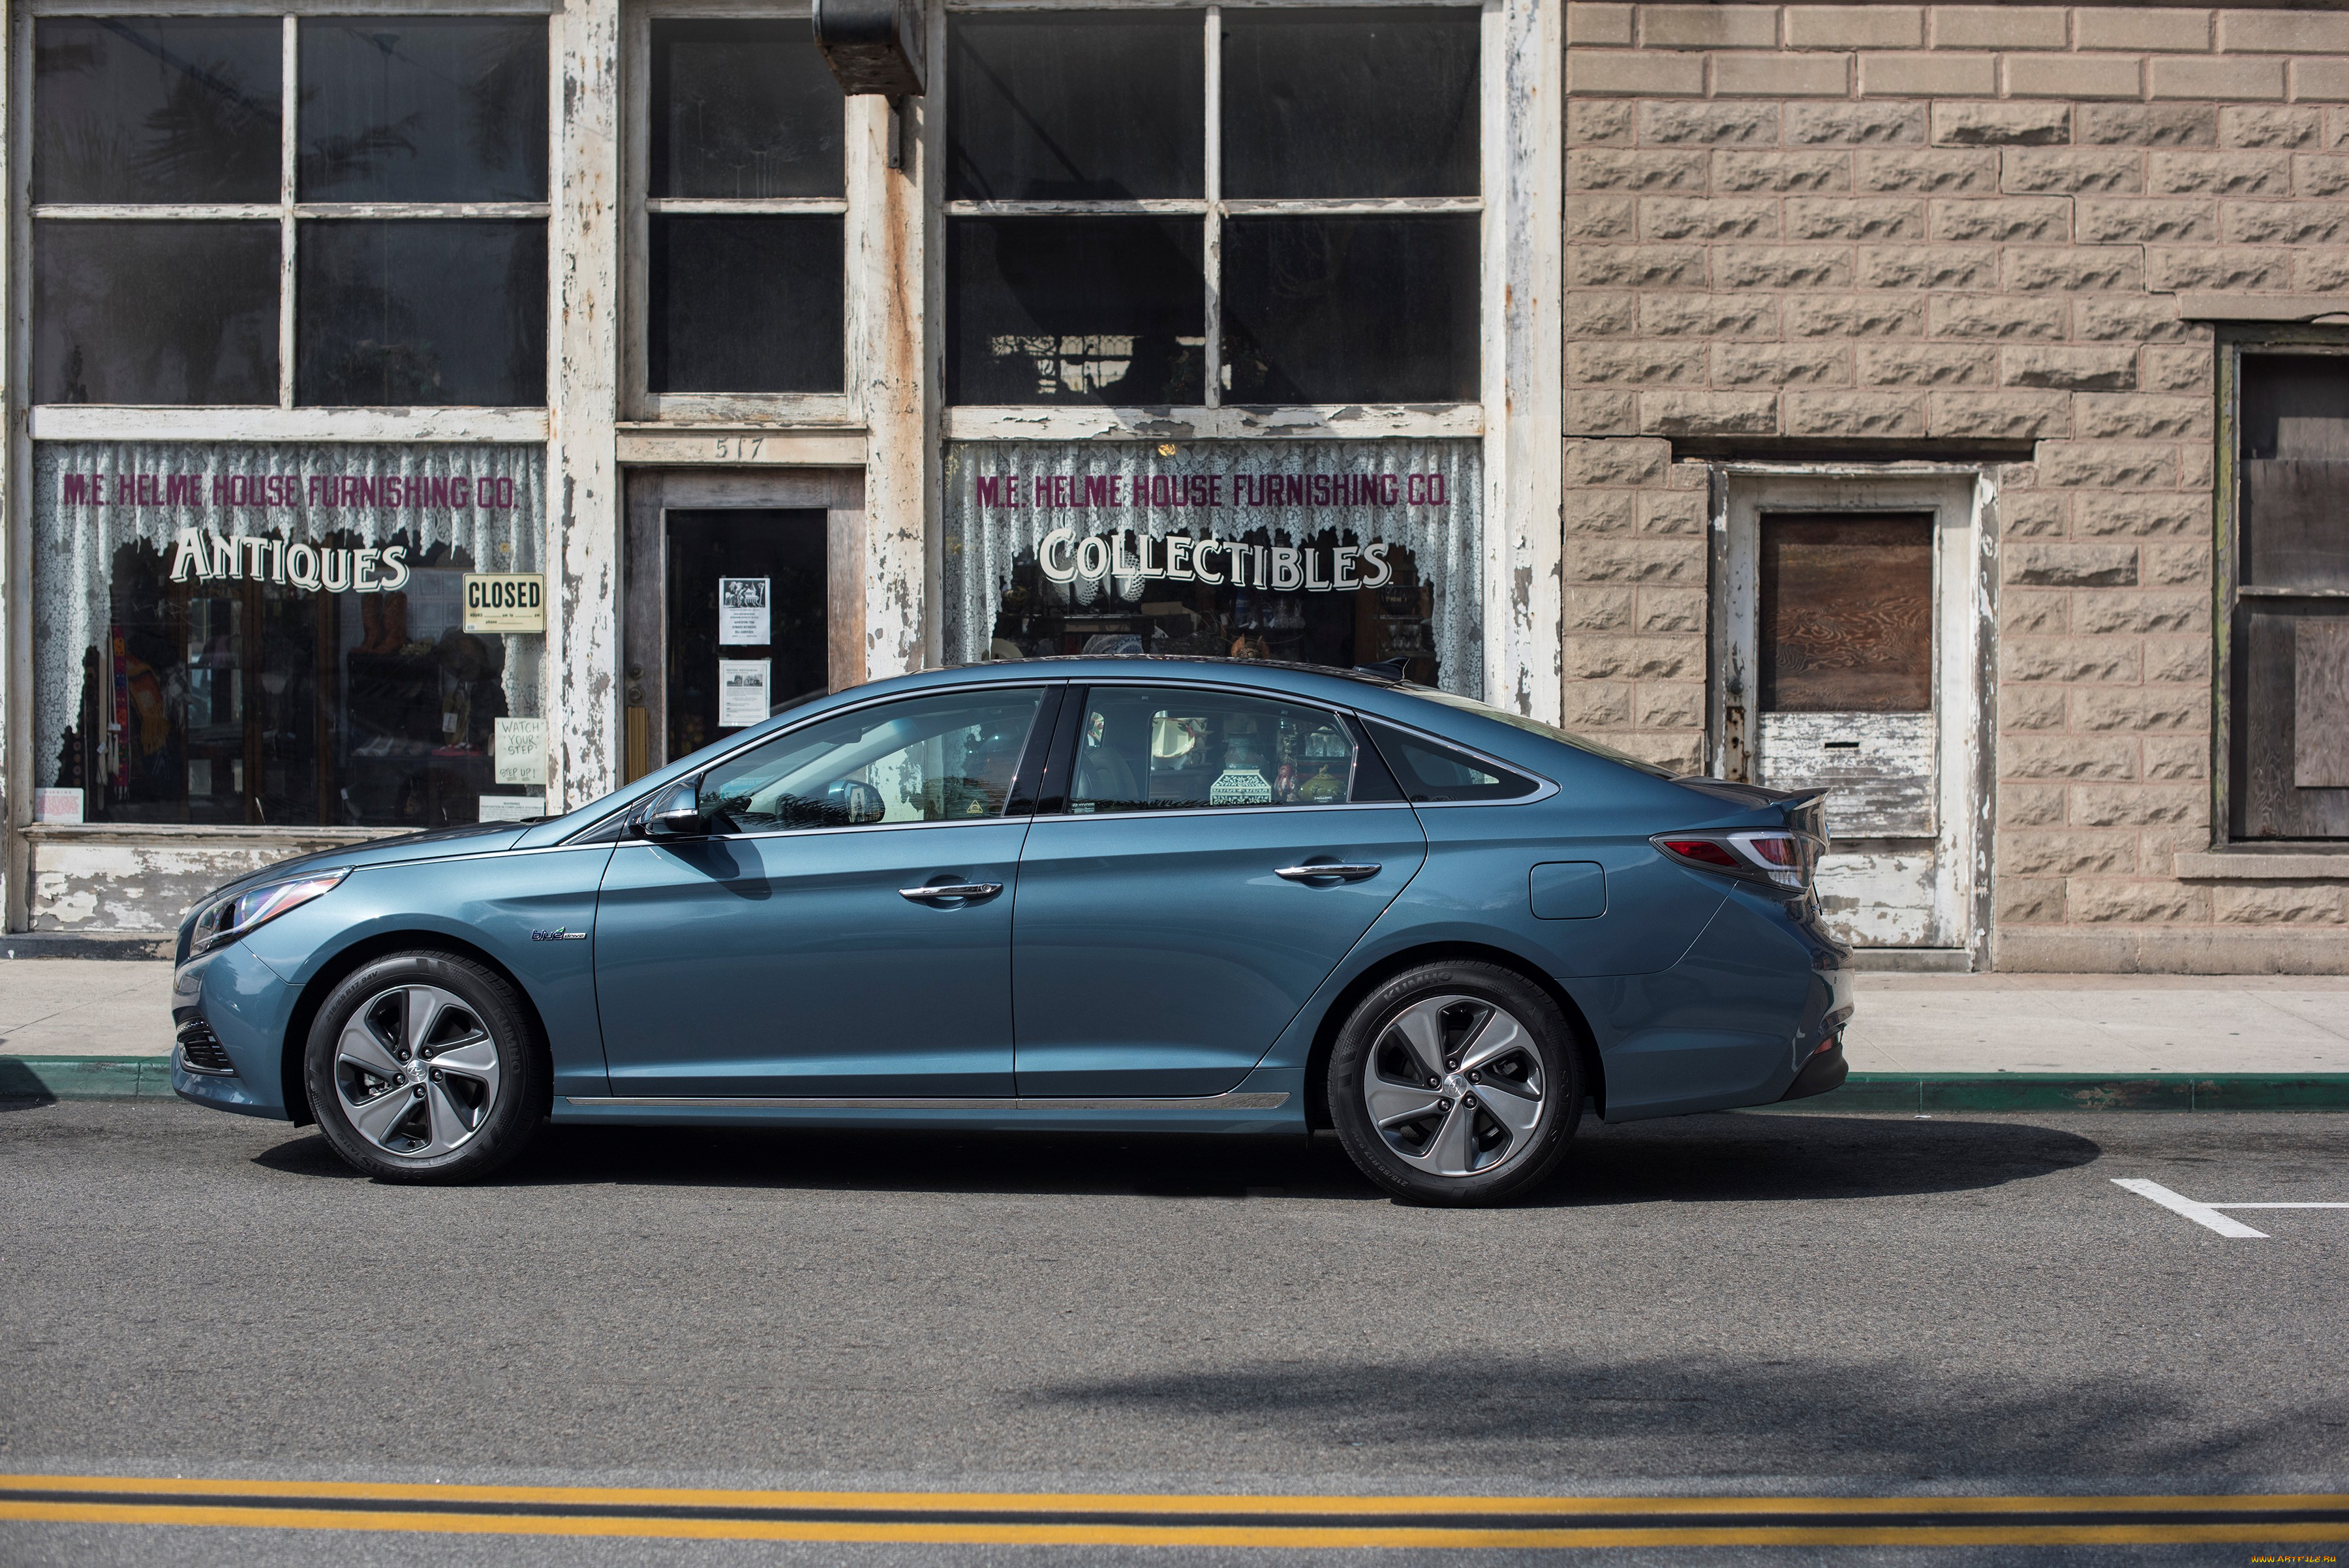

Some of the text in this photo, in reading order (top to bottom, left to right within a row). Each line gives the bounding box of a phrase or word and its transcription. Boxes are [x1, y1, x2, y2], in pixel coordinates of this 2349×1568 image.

[714, 437, 764, 459] 517
[64, 474, 519, 510] M.E. HELME HOUSE FURNISHING CO.
[976, 473, 1451, 508] M.E. HELME HOUSE FURNISHING CO.
[169, 527, 410, 593] ANTIQUES
[1039, 527, 1392, 592] COLLECTIBLES
[468, 581, 540, 608] CLOSED
[501, 720, 539, 733] WATCH
[508, 734, 537, 746] YOUR
[508, 745, 534, 756] STEP
[499, 767, 517, 777] STEP
[531, 928, 564, 940] blue
[1383, 972, 1453, 1002] KUMHO
[493, 1007, 521, 1074] KUMHO
[1364, 1151, 1380, 1166] R17
[1378, 1165, 1409, 1187] 215/55
